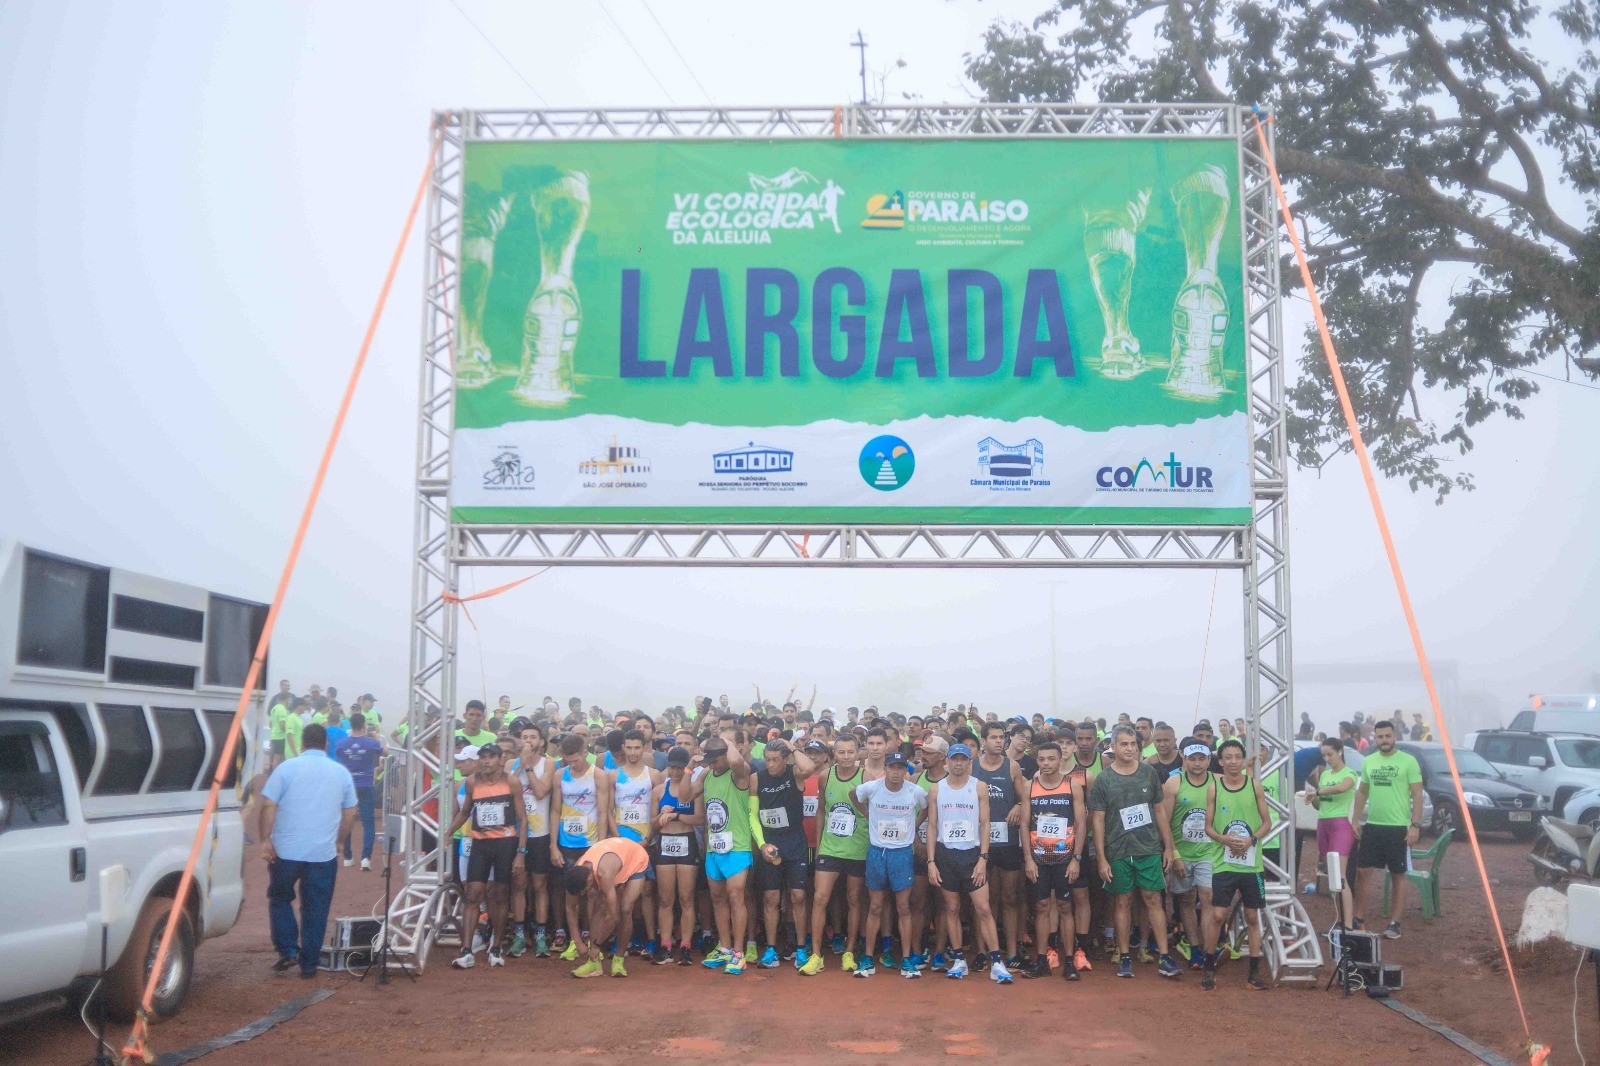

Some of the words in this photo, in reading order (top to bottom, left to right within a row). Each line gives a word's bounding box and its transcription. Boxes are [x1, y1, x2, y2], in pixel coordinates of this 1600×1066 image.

[908, 191, 960, 200] GOVERNO
[962, 191, 976, 199] DE
[673, 193, 699, 210] VI
[704, 192, 823, 211] CORRIDA
[673, 230, 697, 245] DA
[702, 230, 772, 245] ALELUIA
[620, 267, 1076, 378] LARGADA
[992, 479, 1020, 487] Municipal
[802, 804, 815, 813] 70
[481, 813, 498, 822] 255
[624, 812, 640, 821] 246
[766, 816, 781, 825] 491
[1127, 813, 1144, 825] 220
[568, 824, 584, 833] 236
[830, 821, 847, 831] 378
[1041, 825, 1060, 835] 332
[882, 830, 899, 838] 431
[948, 830, 967, 838] 292
[1187, 831, 1204, 839] 375
[665, 845, 681, 853] 302
[713, 841, 726, 850] 400
